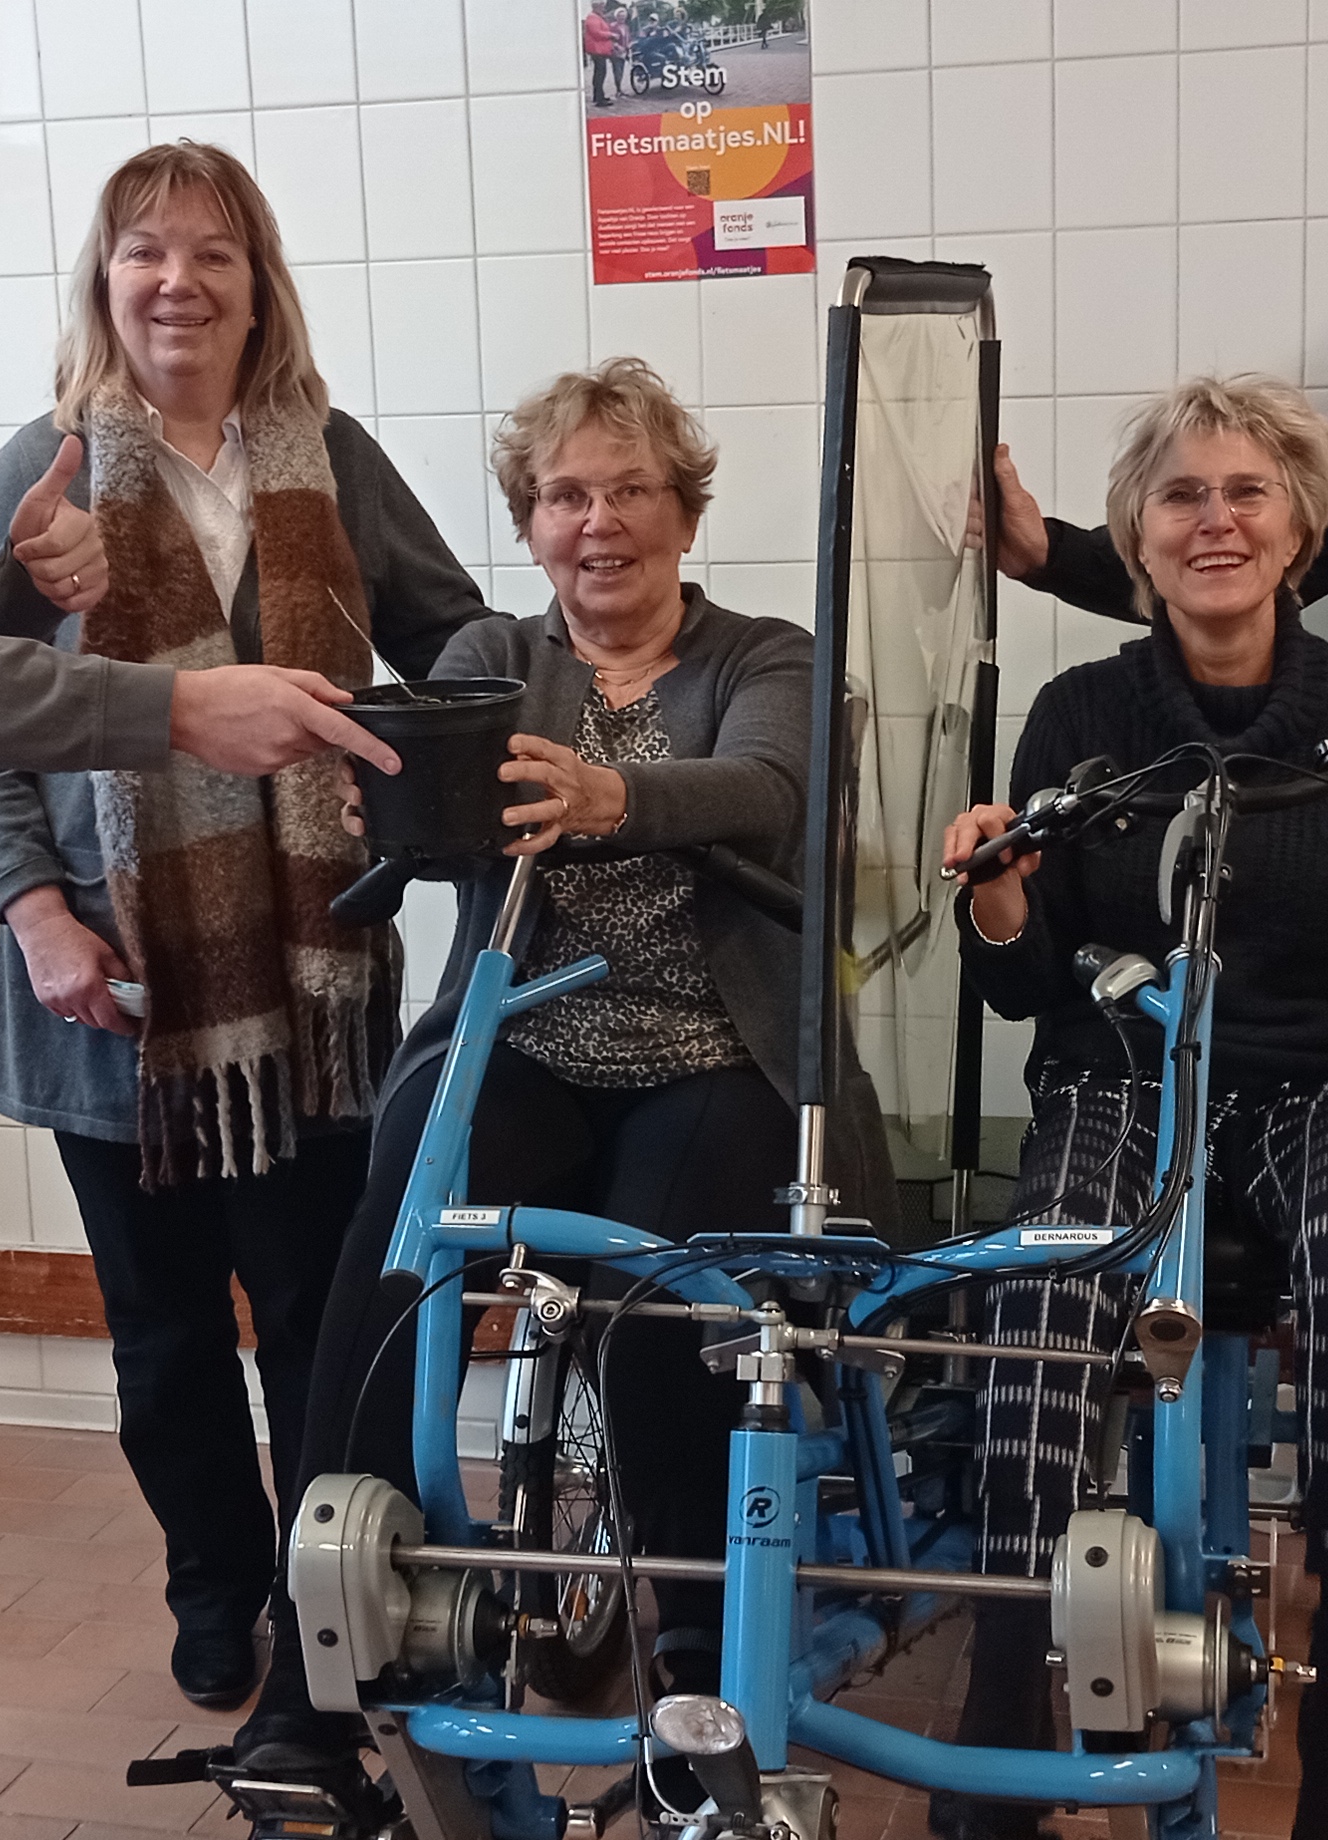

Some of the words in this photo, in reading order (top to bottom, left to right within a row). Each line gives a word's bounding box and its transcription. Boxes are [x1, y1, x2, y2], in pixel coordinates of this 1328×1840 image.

[662, 65, 727, 88] Stem
[680, 100, 712, 124] op
[590, 120, 806, 157] Fietsmaatjes.NL!
[720, 212, 754, 225] oranje
[723, 223, 754, 234] fonds
[1034, 1232, 1098, 1241] BERNARDUS
[729, 1535, 791, 1548] vanraam
